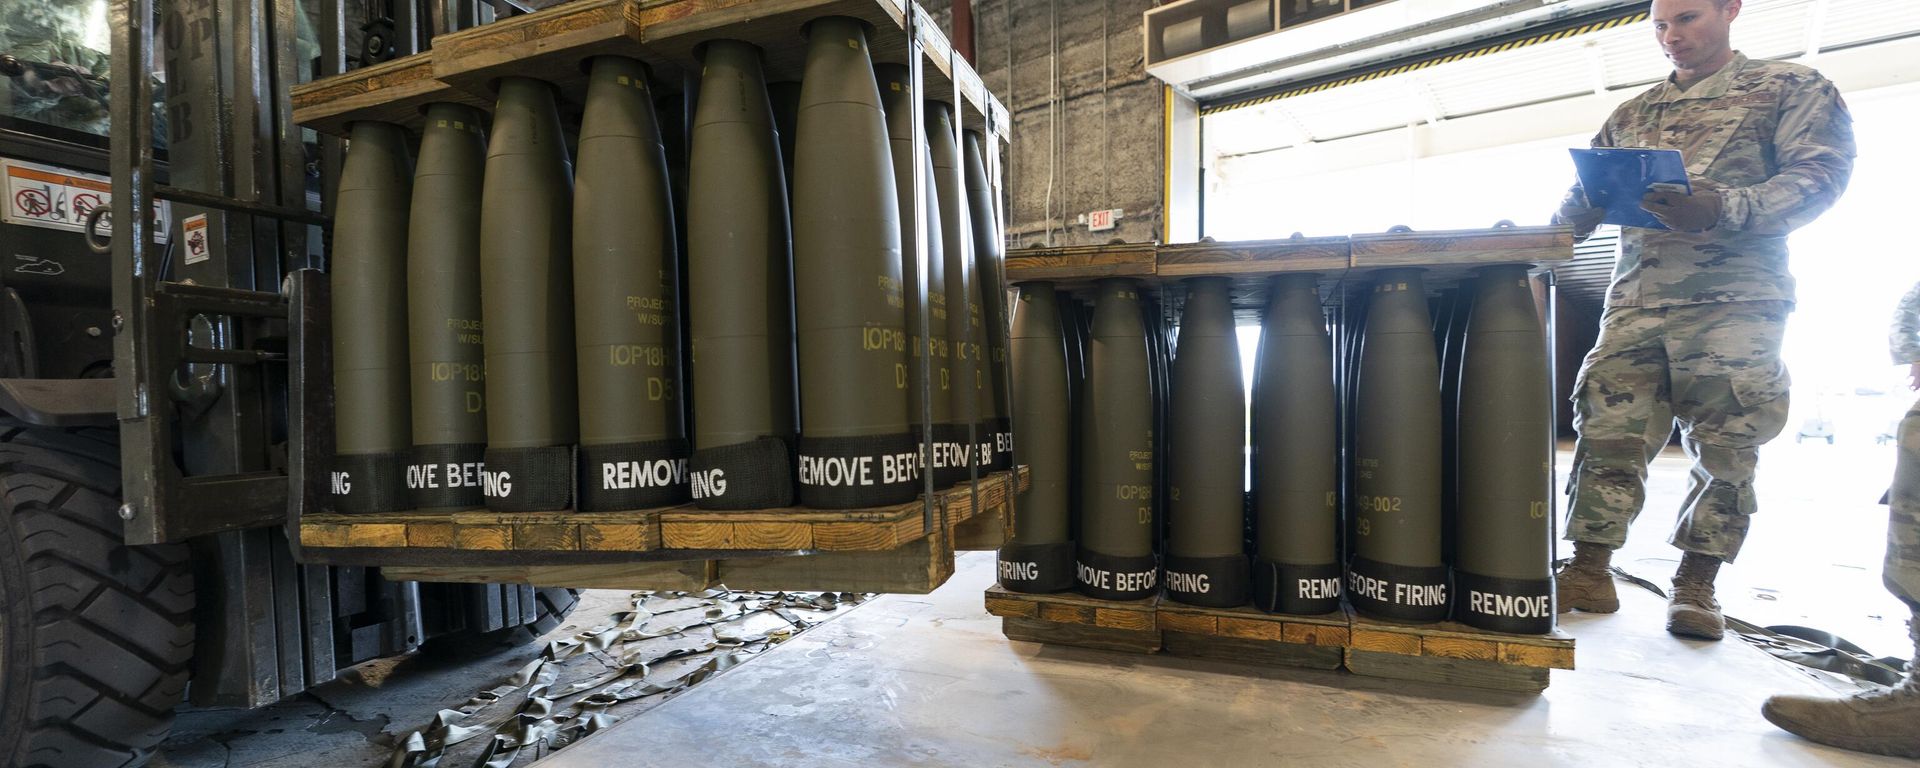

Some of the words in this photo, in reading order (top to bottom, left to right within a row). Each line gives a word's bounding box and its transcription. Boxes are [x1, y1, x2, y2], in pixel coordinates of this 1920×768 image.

[1092, 211, 1109, 228] EXIT
[895, 362, 908, 389] D
[406, 463, 440, 489] OVE
[602, 458, 689, 490] REMOVE
[799, 455, 874, 487] REMOVE
[999, 560, 1039, 581] FIRING
[1166, 570, 1210, 594] FIRING
[1395, 583, 1447, 606] FIRING
[1470, 590, 1550, 619] REMOVE
